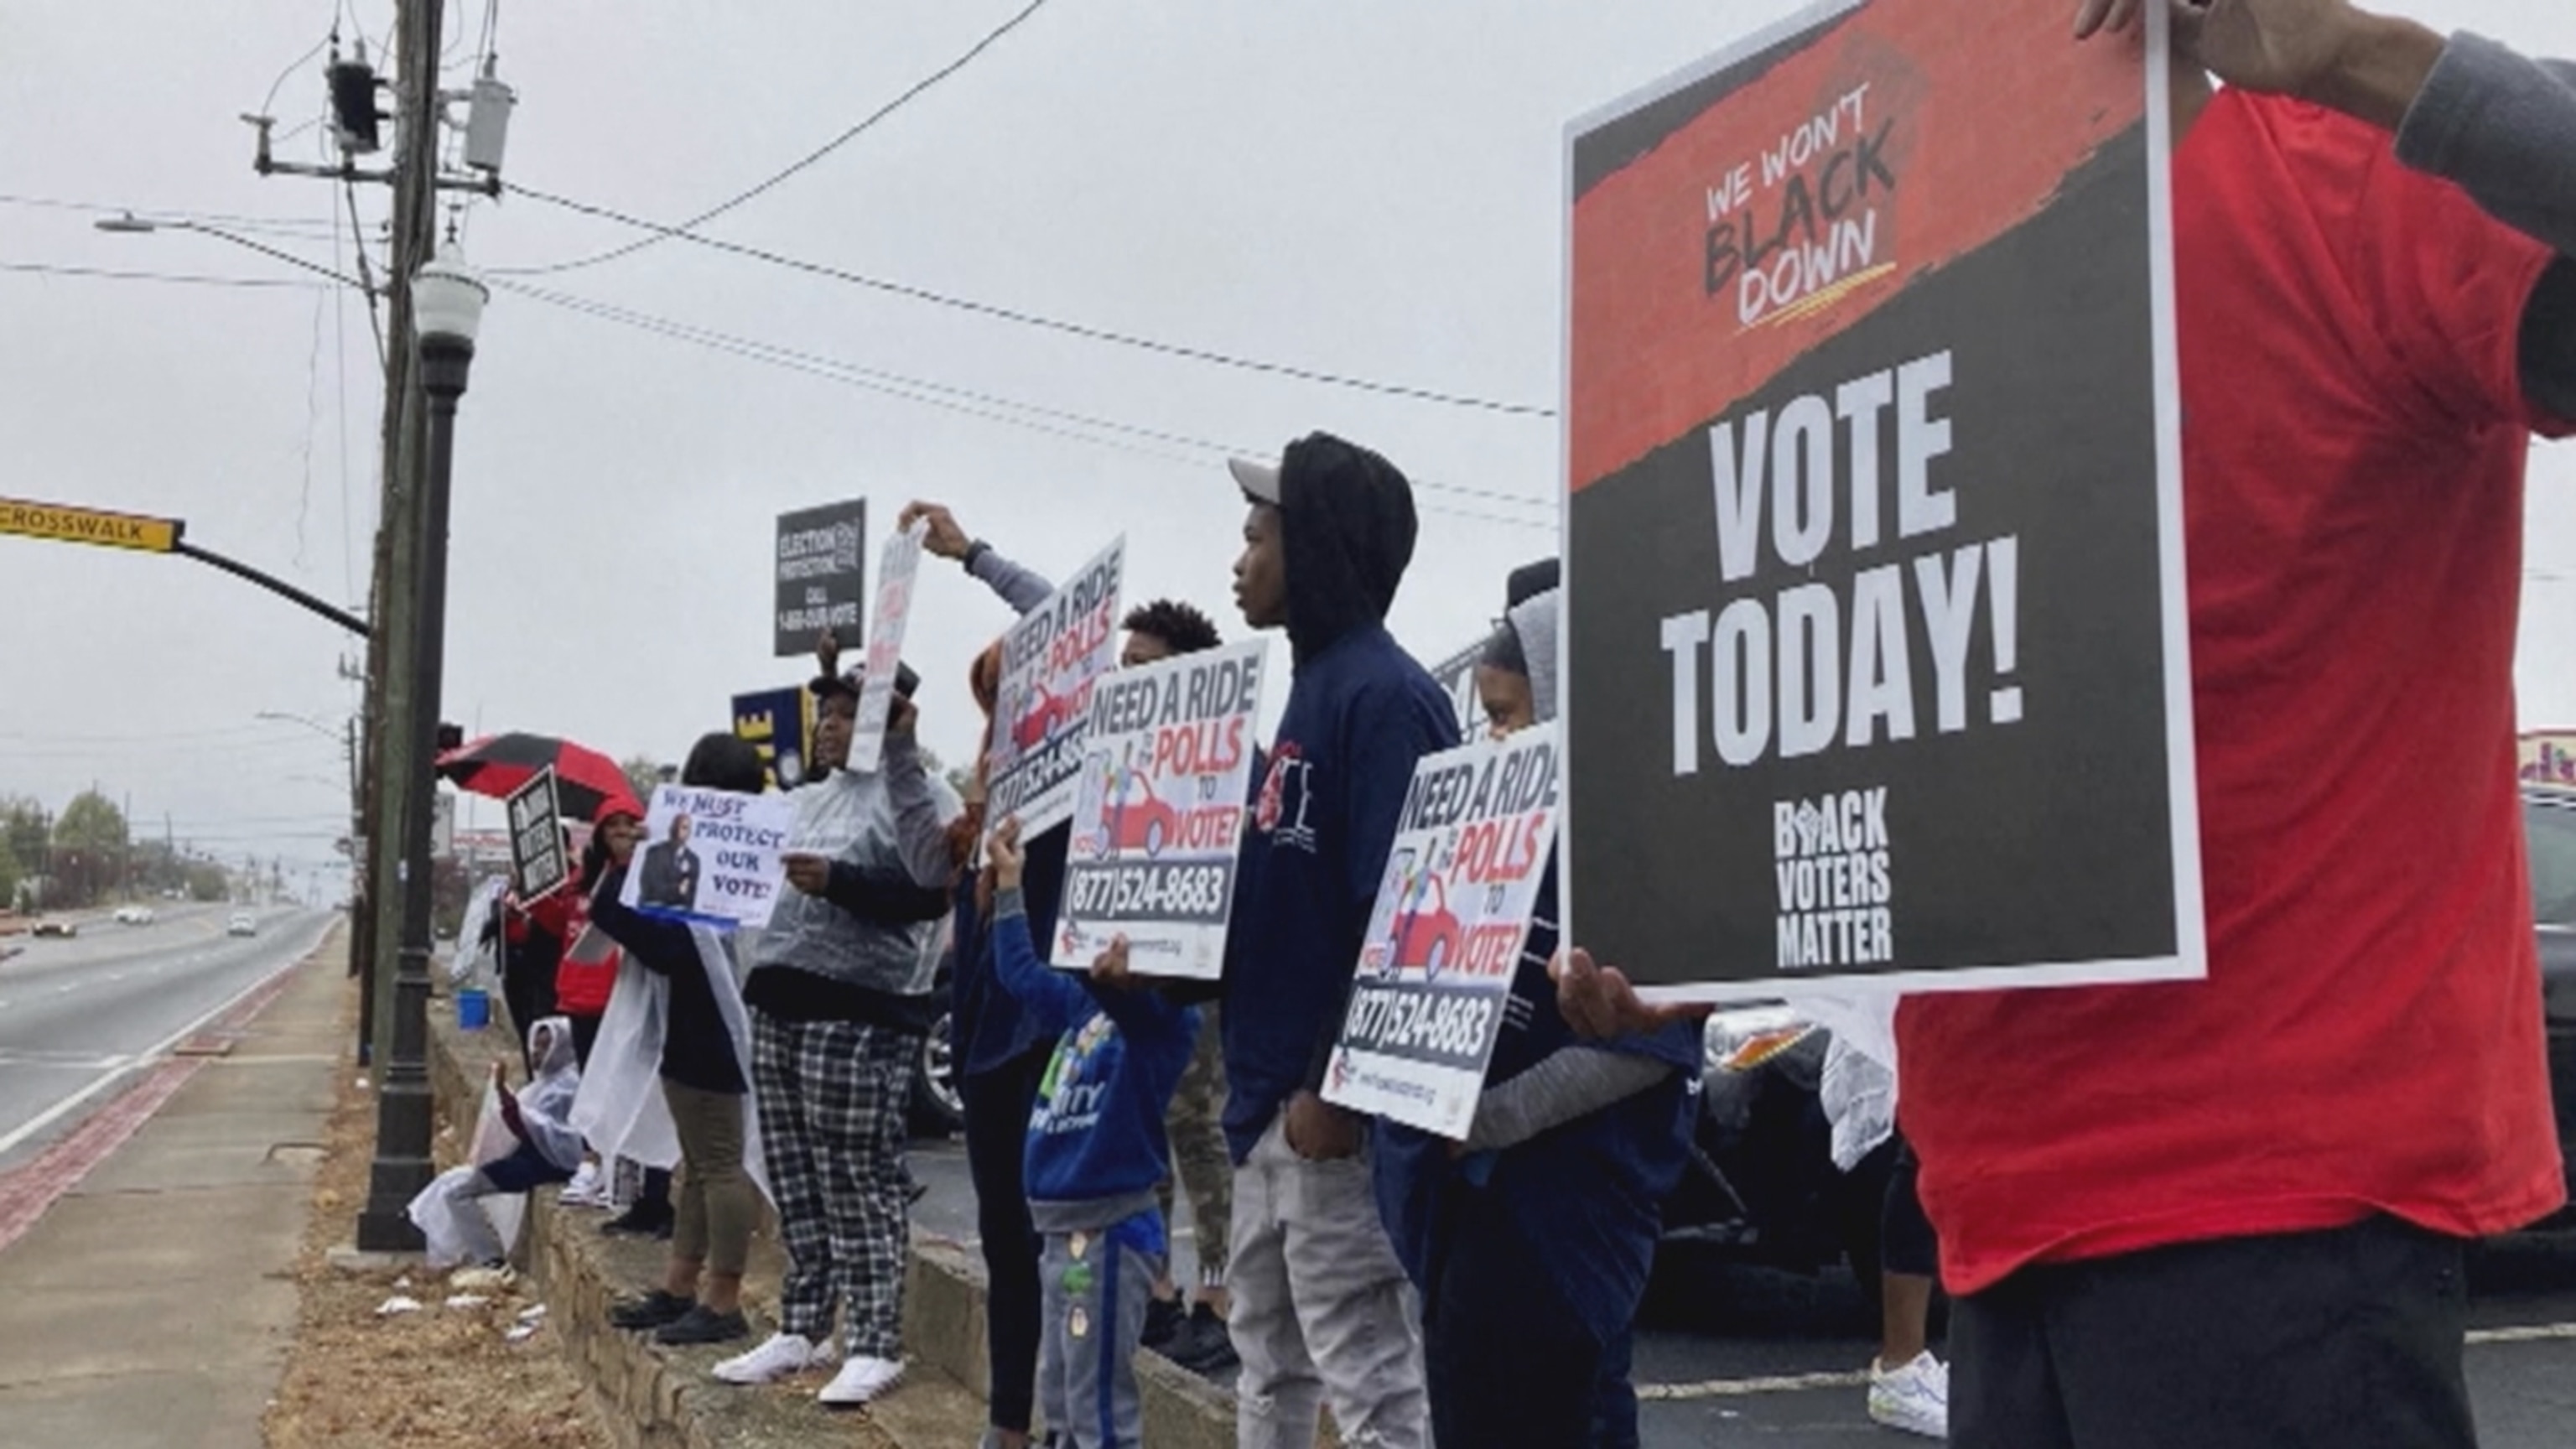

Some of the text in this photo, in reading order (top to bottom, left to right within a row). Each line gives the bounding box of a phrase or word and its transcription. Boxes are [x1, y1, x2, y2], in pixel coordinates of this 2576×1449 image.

[1706, 81, 1869, 220] WE WON'T
[1704, 117, 1895, 298] BLACK
[1738, 210, 1875, 325] DOWN
[1708, 350, 1956, 582] VOTE
[1005, 550, 1120, 676] NEED A RIDE
[1050, 597, 1111, 683] POLLS
[1660, 534, 2023, 776] TODAY!
[1090, 656, 1259, 737] NEED A RIDE
[1154, 718, 1244, 778] POLLS
[691, 793, 747, 816] MUST
[1200, 775, 1216, 799] TO
[1400, 765, 1473, 833] NEED
[1467, 756, 1496, 821] A
[695, 821, 785, 849] PROTECT
[1175, 807, 1239, 848] VOTE?
[1450, 813, 1546, 886] POLLS
[1774, 787, 1888, 859] BACK
[716, 849, 759, 872] OUR
[1067, 866, 1224, 917] (877)524-8683
[1775, 852, 1892, 911] VOTERS
[1484, 884, 1505, 914] TO
[1453, 924, 1520, 975] VOTE?
[1777, 907, 1893, 969] MATTER
[1343, 986, 1492, 1056] (877)524-8683
